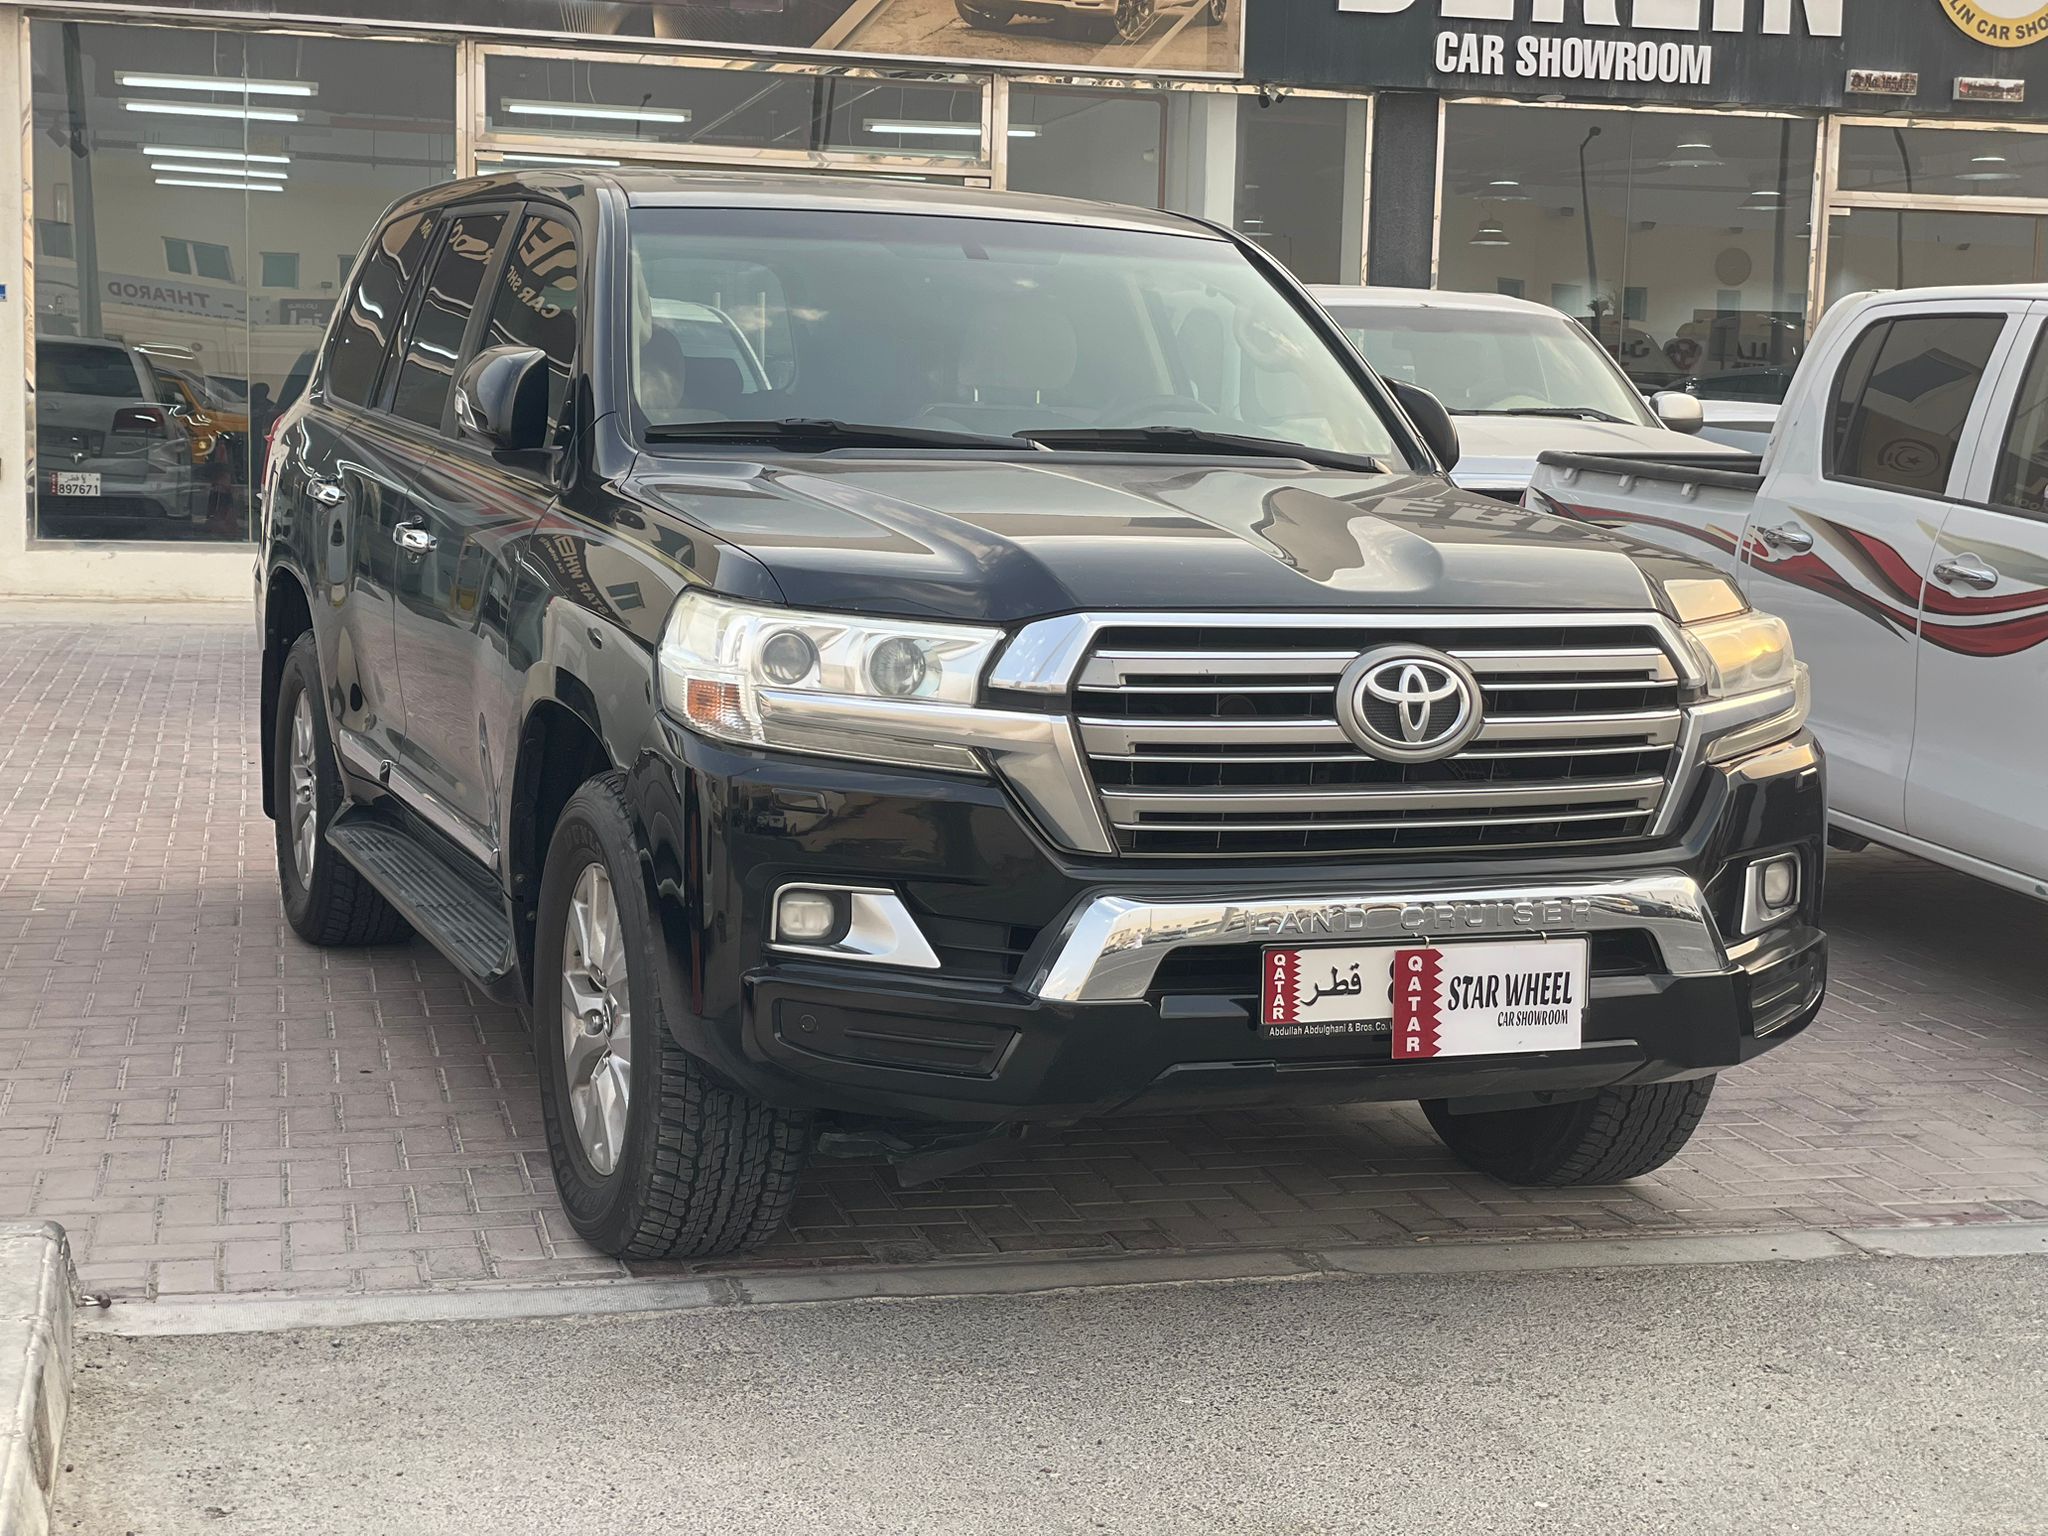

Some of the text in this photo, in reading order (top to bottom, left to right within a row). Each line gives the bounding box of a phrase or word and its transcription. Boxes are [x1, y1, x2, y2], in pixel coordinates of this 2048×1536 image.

[1947, 0, 2048, 40] LIN CAR SHO
[1435, 31, 1713, 85] CAR SHOWROOM
[58, 484, 99, 495] 897671
[1249, 899, 1592, 936] LAND CRUISER
[1272, 953, 1287, 1020] QATAR
[1300, 962, 1362, 1006] قطر
[1406, 955, 1423, 1052] QATAR
[1447, 971, 1572, 1011] STAR WHEEL
[1269, 1026, 1302, 1036] Abdullah
[1303, 1023, 1346, 1035] Abdulghani
[1347, 1023, 1354, 1032] &
[1355, 1022, 1375, 1032] Bros.
[1375, 1021, 1388, 1031] Co.
[1497, 1009, 1568, 1027] CAR SHOWROOM
